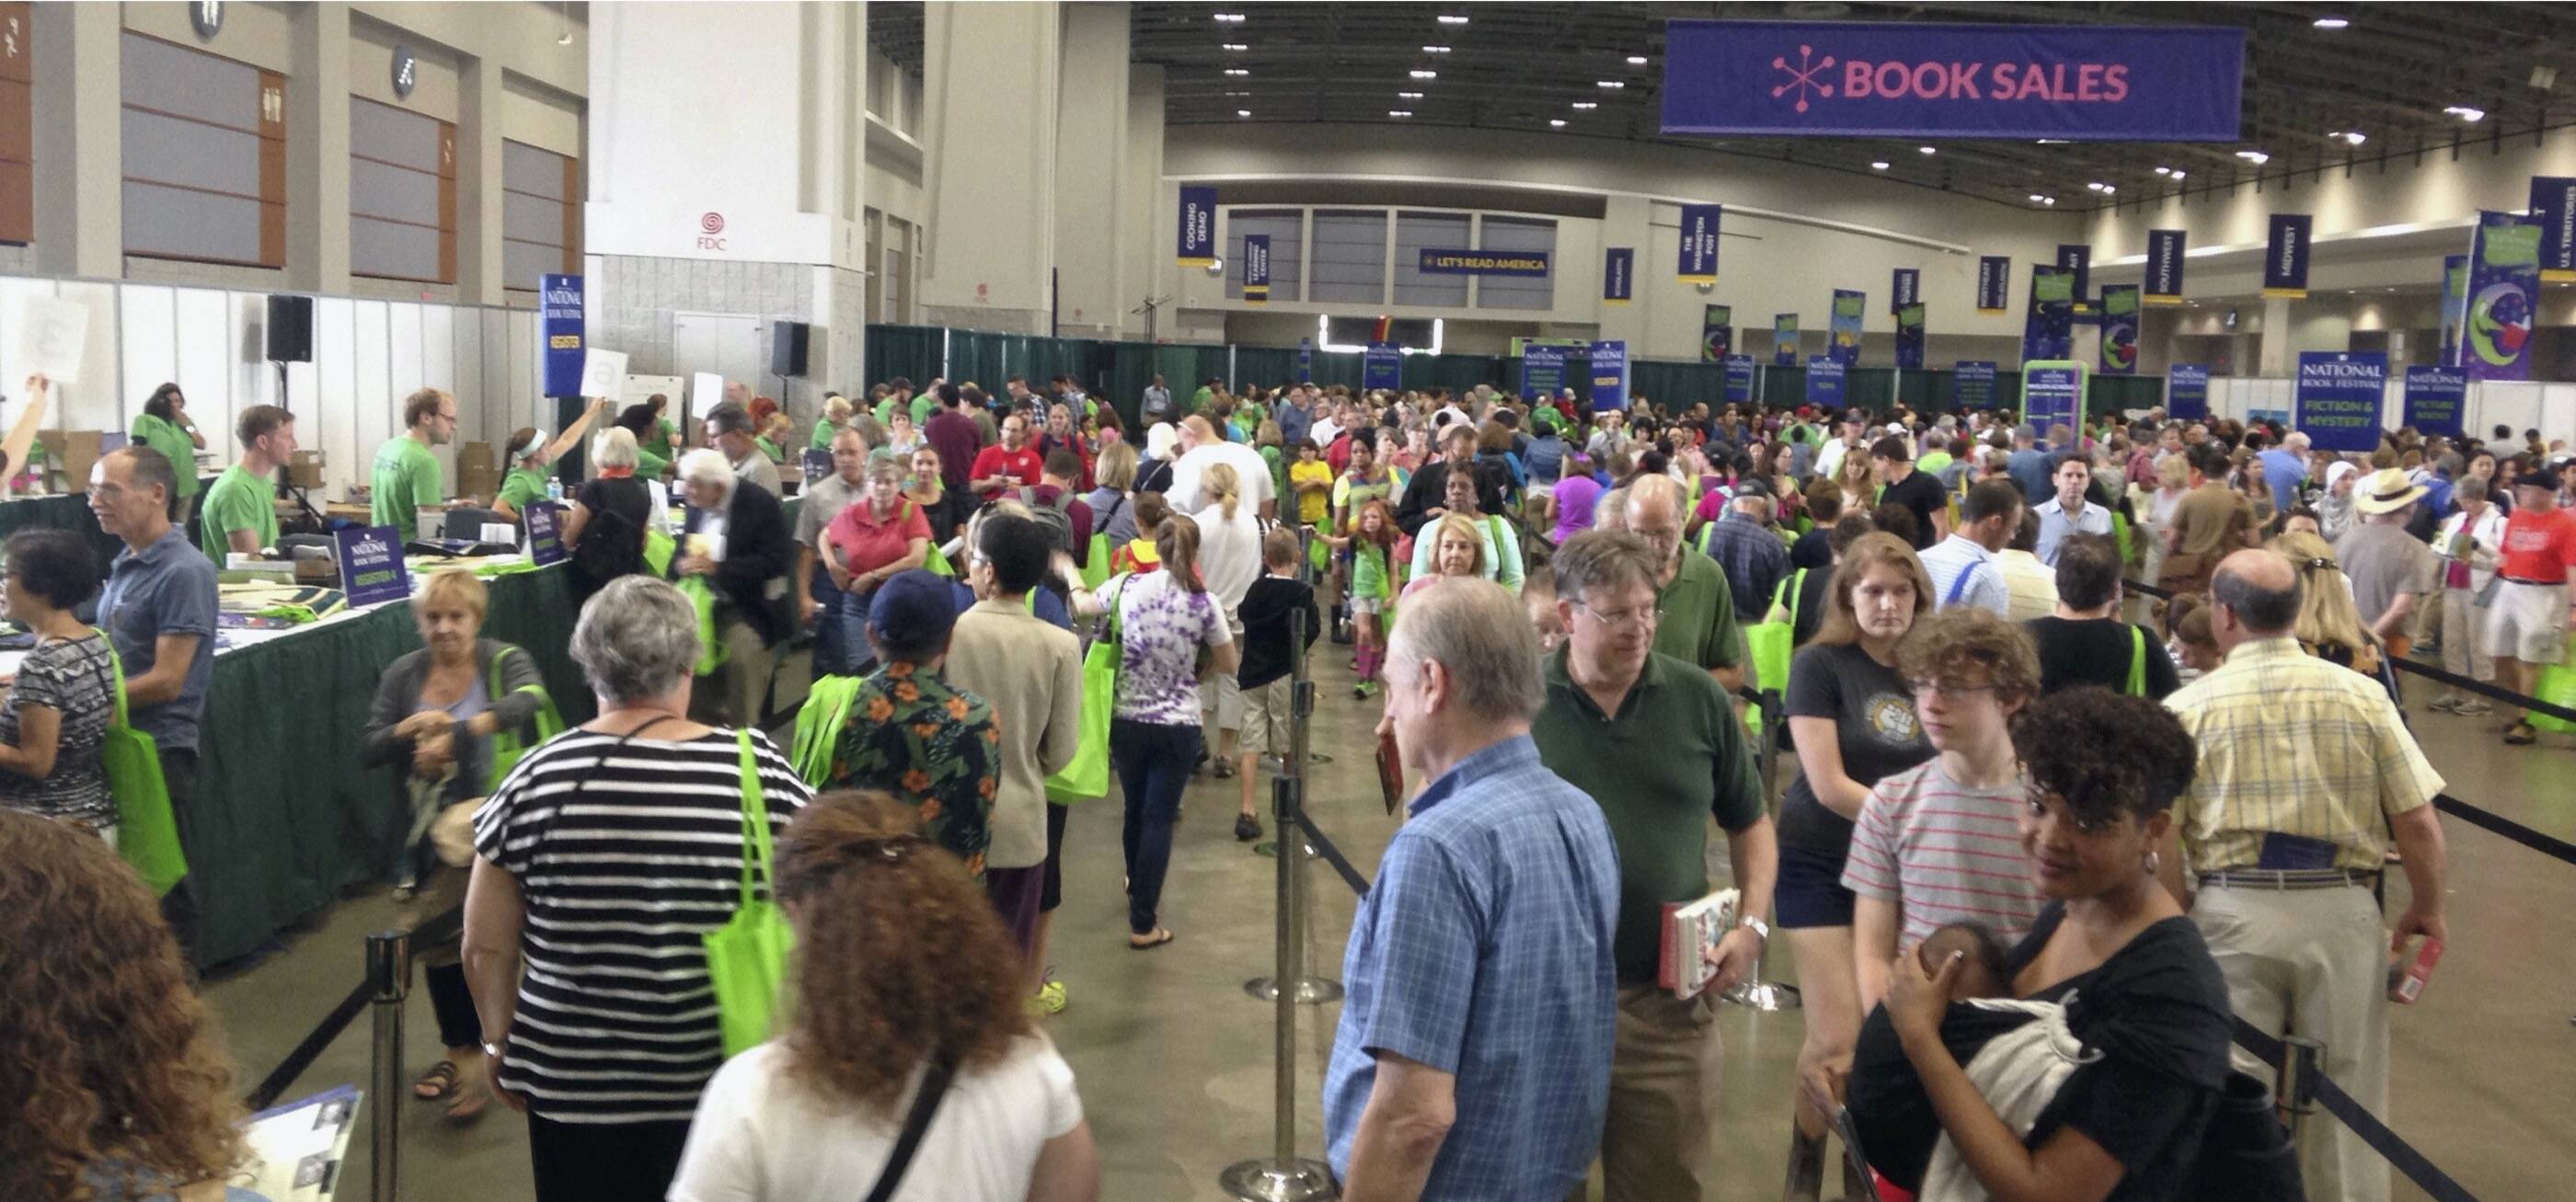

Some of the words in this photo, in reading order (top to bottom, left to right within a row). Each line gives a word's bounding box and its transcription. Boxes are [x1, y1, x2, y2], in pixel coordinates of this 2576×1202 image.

[1845, 61, 1984, 99] BOOK
[1991, 63, 2130, 102] SALES
[1186, 202, 1197, 250] COOKING
[1198, 212, 1207, 242] DEMO
[697, 236, 727, 251] FDC
[1684, 235, 1693, 251] THE
[1694, 216, 1705, 271] WASHINGTON
[1706, 234, 1715, 254] POST
[2282, 225, 2295, 277] MIDWEST
[1437, 257, 1465, 268] LET'S
[1466, 258, 1494, 269] READ
[1495, 258, 1546, 269] AMERICA
[2159, 235, 2173, 292] SOUTHWEST
[2303, 364, 2381, 378] NATIONAL
[2302, 378, 2331, 388] BOOK
[2336, 378, 2381, 390] FESTIVAL
[2409, 374, 2464, 384] NATIONAL
[2306, 400, 2362, 413] FICTION
[2306, 415, 2372, 428] MYSTERY
[351, 540, 388, 555] NATIONAL
